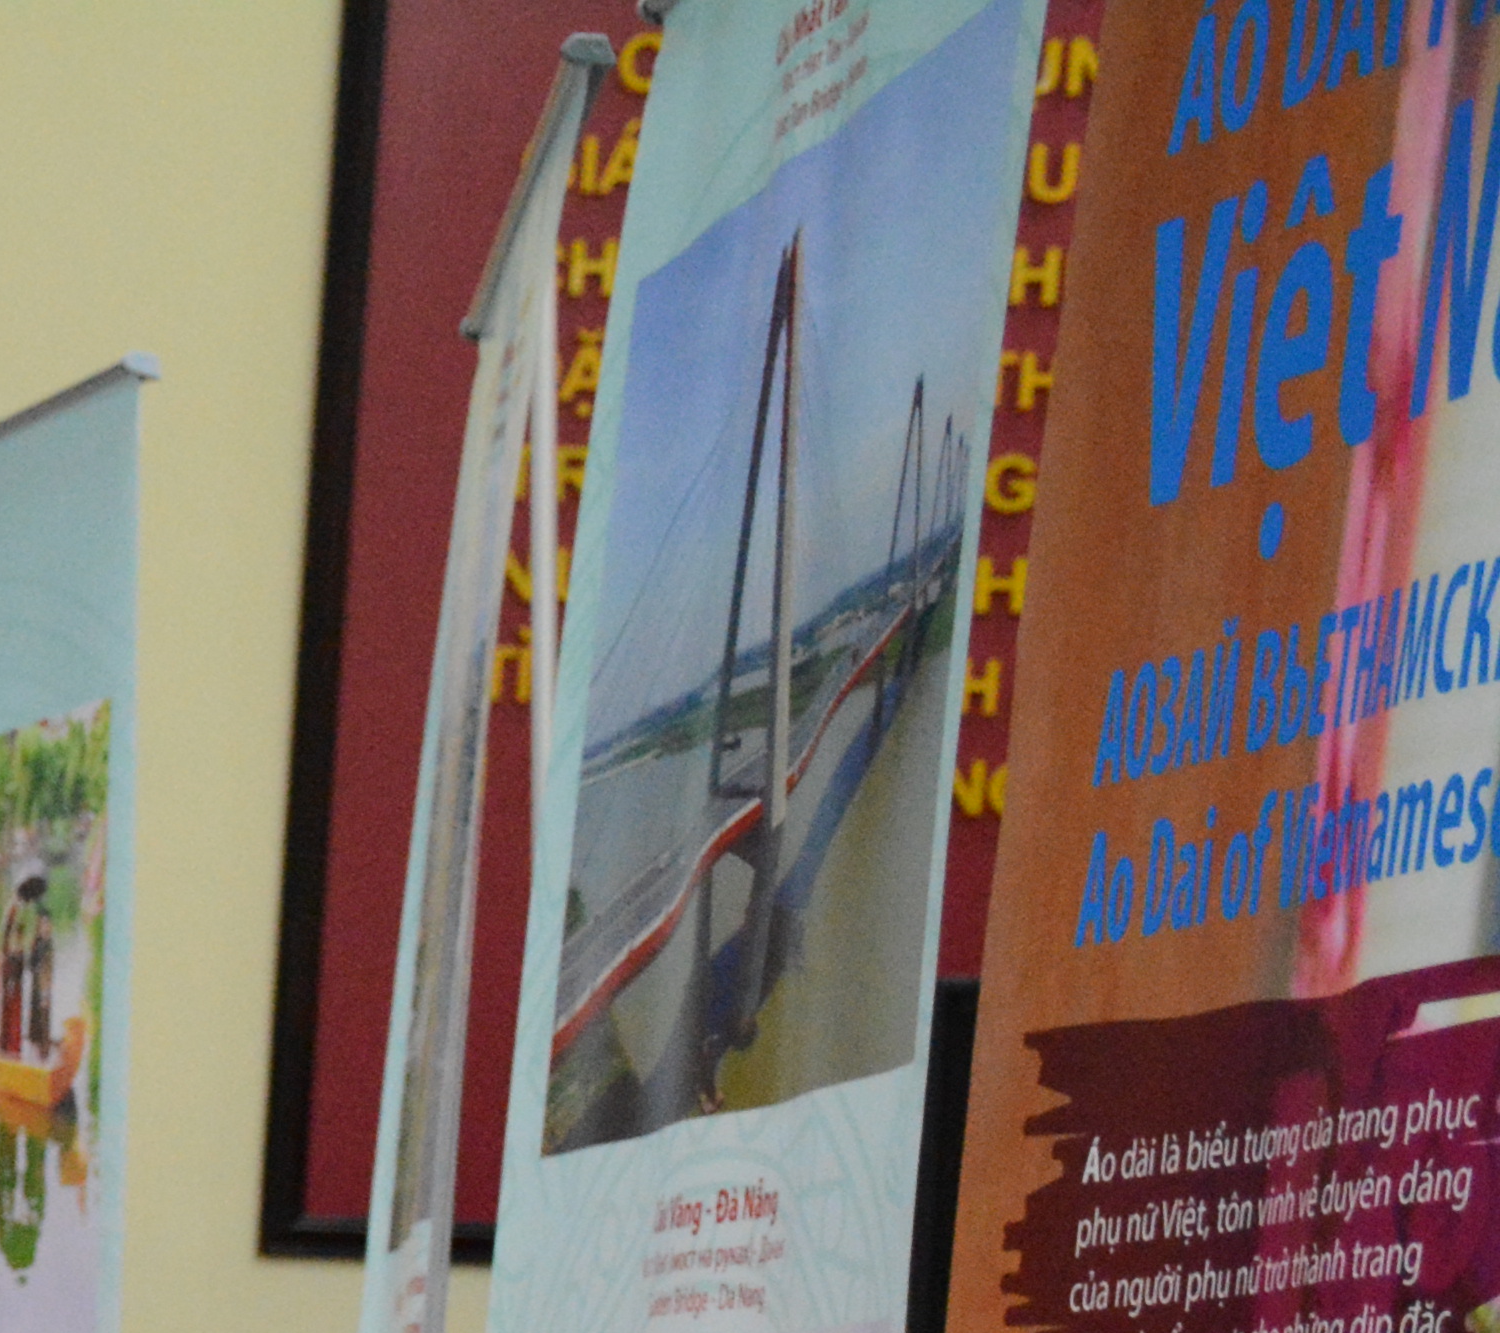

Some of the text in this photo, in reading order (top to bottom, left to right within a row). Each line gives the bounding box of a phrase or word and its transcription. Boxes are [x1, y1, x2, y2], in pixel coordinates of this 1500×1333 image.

[1150, 154, 1403, 560] Việt
[1092, 617, 1242, 788] АОЗАЙ
[1074, 828, 1134, 948] Ao
[1141, 805, 1216, 938] Dai
[1222, 787, 1277, 920] of
[1082, 1087, 1482, 1185] Áo dài là biểu tượng của trang phục
[1072, 1207, 1121, 1256] phụ
[1126, 1202, 1159, 1244] nữ
[1161, 1197, 1211, 1248] Việt,
[1216, 1192, 1253, 1234] tôn
[1257, 1181, 1296, 1226] vinh
[1321, 1166, 1391, 1222] duyên
[1398, 1157, 1473, 1212] dáng
[1068, 1270, 1109, 1314] của
[1114, 1264, 1183, 1318] người
[1185, 1259, 1232, 1312] phụ
[1235, 1256, 1261, 1298] nữ
[1290, 1239, 1346, 1288] thành
[1352, 1240, 1424, 1286] trang
